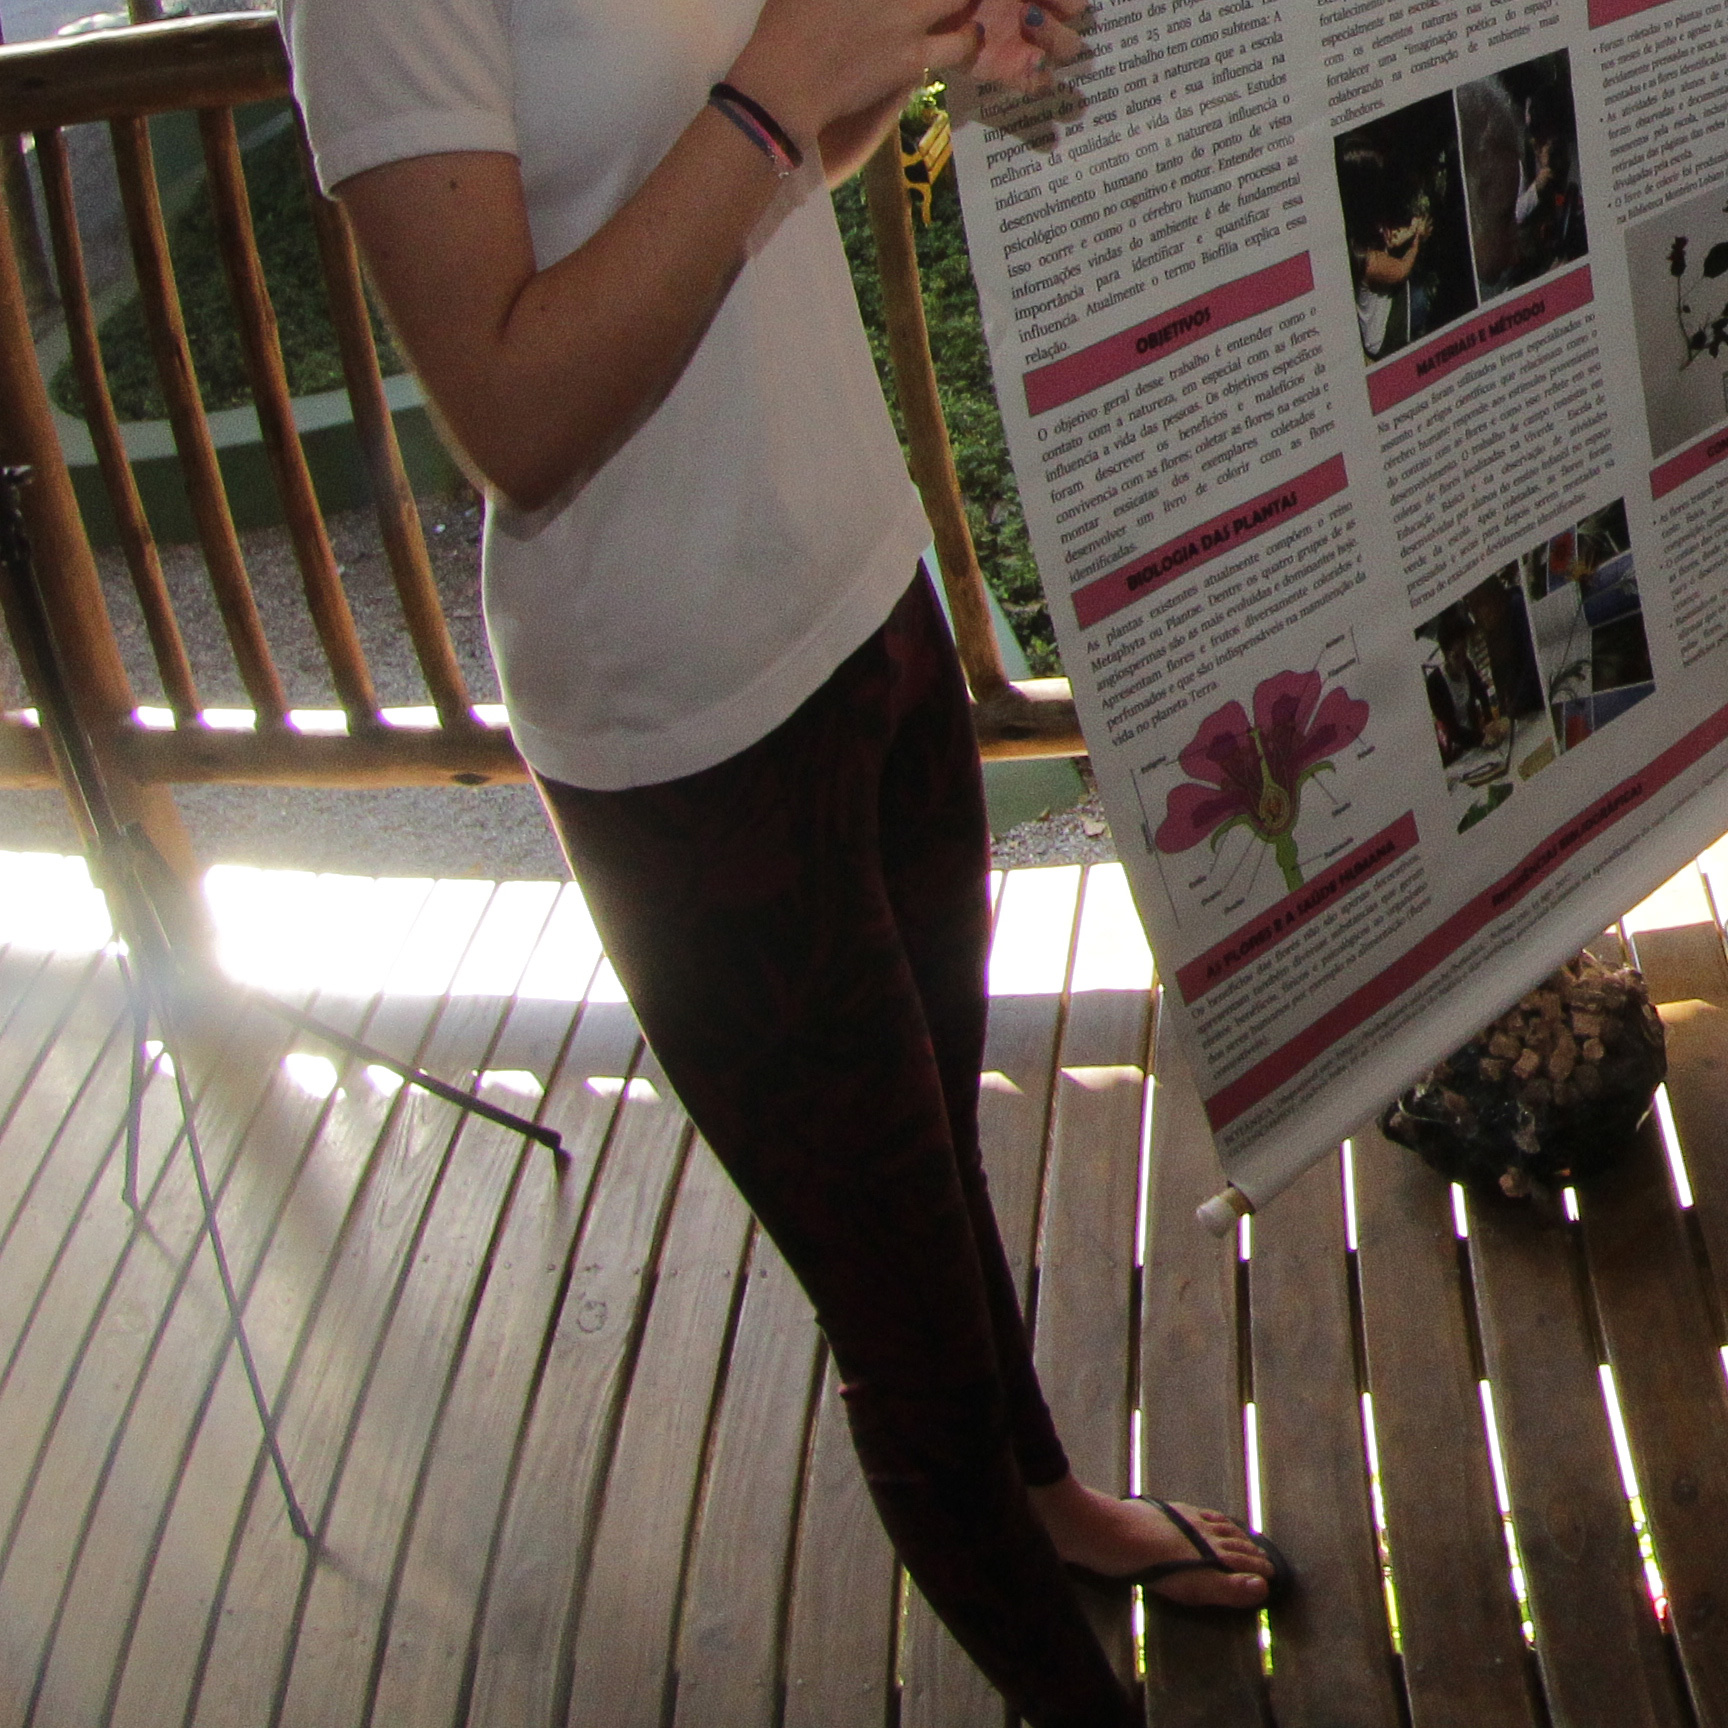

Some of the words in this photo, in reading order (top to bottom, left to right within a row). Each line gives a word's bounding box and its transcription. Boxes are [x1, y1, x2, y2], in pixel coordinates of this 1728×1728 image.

[998, 188, 1096, 234] desenvolvimento
[1102, 168, 1149, 195] humano
[1155, 155, 1184, 174] tanto
[1190, 145, 1205, 160] do
[1211, 133, 1243, 156] ponto
[1248, 123, 1262, 138] de
[1268, 114, 1293, 130] vista
[1134, 306, 1212, 355] OBJETIVOS
[1125, 541, 1200, 592] BIOLOGIA
[1199, 523, 1231, 552] DAS
[1231, 490, 1298, 536] PLANTAS
